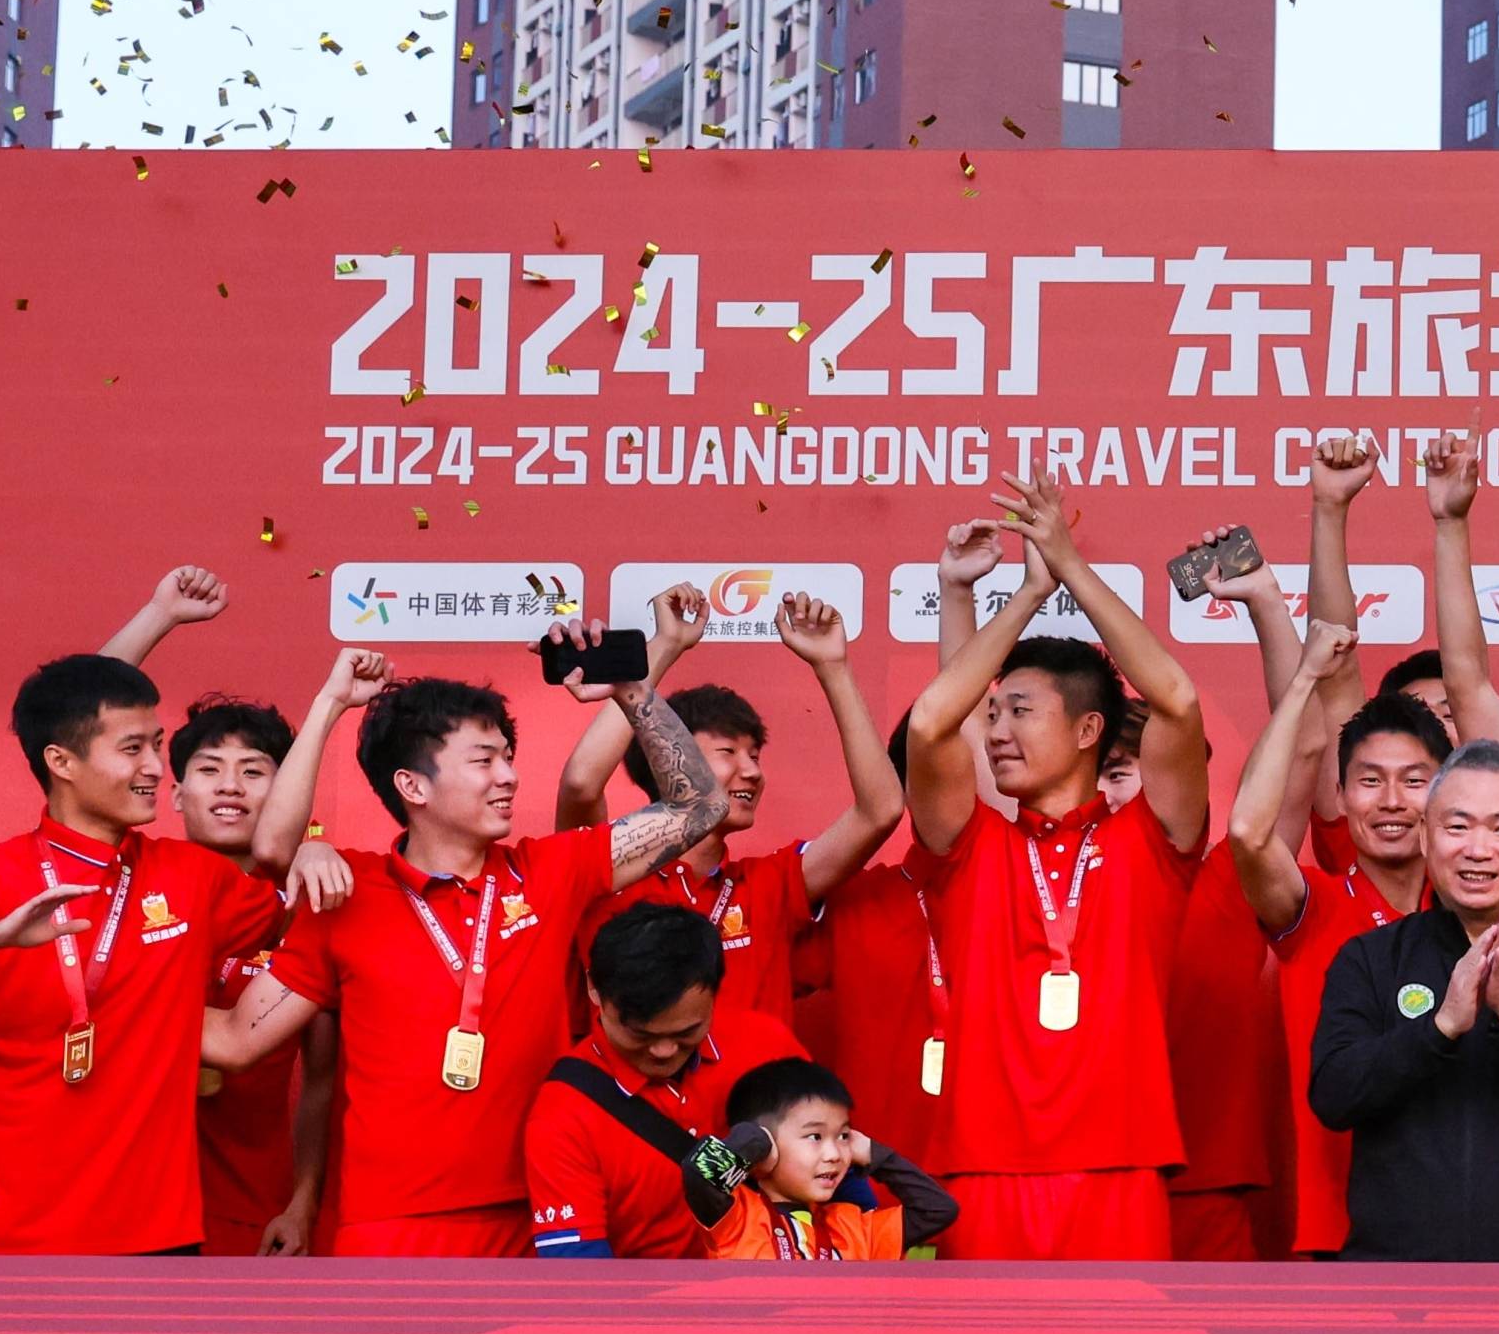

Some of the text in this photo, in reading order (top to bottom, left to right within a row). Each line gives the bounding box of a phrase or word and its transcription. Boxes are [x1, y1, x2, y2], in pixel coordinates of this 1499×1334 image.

[323, 426, 588, 485] 2024-25
[605, 426, 989, 486] GUANGDONG
[1008, 427, 1256, 486] TRAVEL
[408, 592, 569, 617] 中国体育彩票
